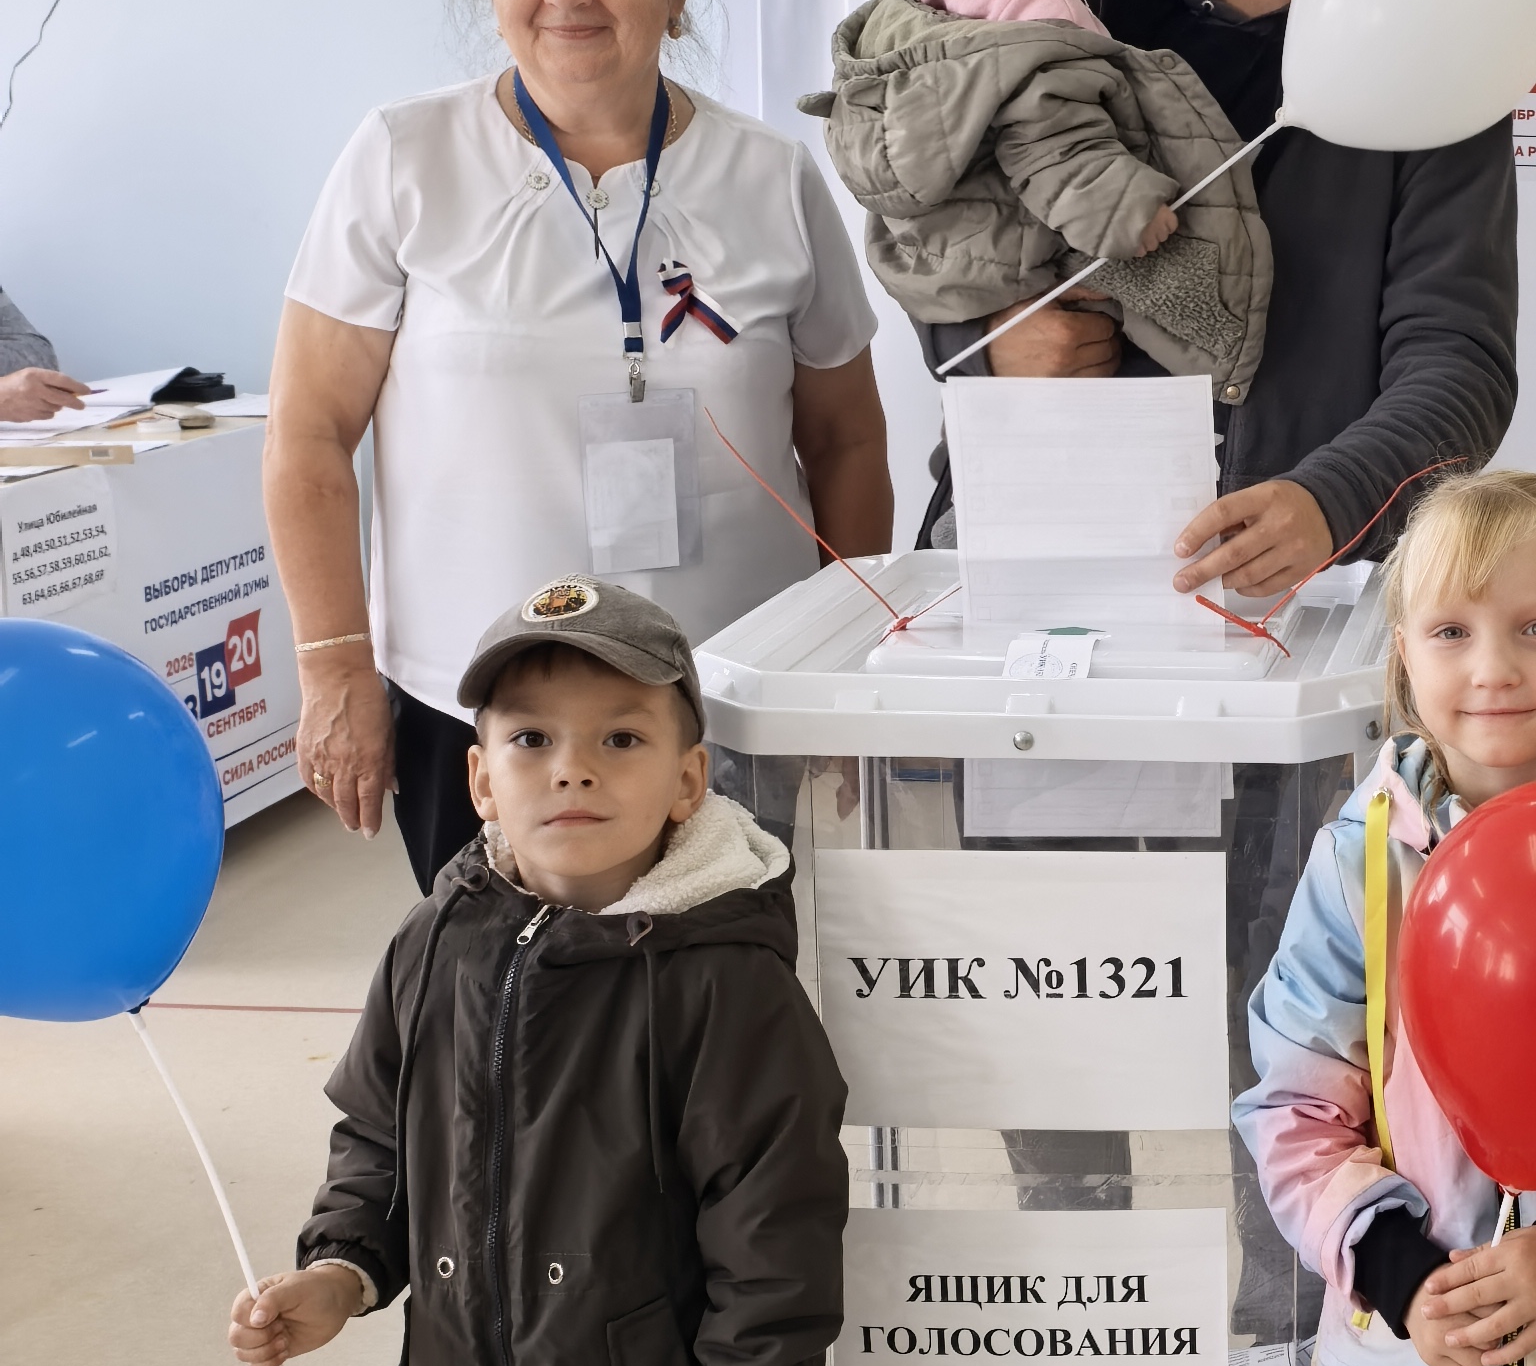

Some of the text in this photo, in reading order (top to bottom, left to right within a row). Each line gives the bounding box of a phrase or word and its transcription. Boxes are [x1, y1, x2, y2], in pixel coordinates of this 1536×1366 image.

[46, 504, 98, 526] Юбилейная
[144, 545, 266, 603] ВЫБОРЫ ДЕПУТАТОВ
[144, 574, 270, 634] ГОСУДАРСТВЕННОЙ ДУМЫ
[165, 652, 195, 678] 2026
[200, 629, 257, 702] 19 20
[207, 698, 267, 738] СЕНТЯБРЯ
[222, 735, 298, 786] СИЛА РОССИИ
[845, 954, 1189, 1000] УИК №1321
[905, 1274, 1149, 1308] ЯЩИК ДЛЯ
[860, 1324, 1201, 1359] ГОЛОСОВАНИЯ
